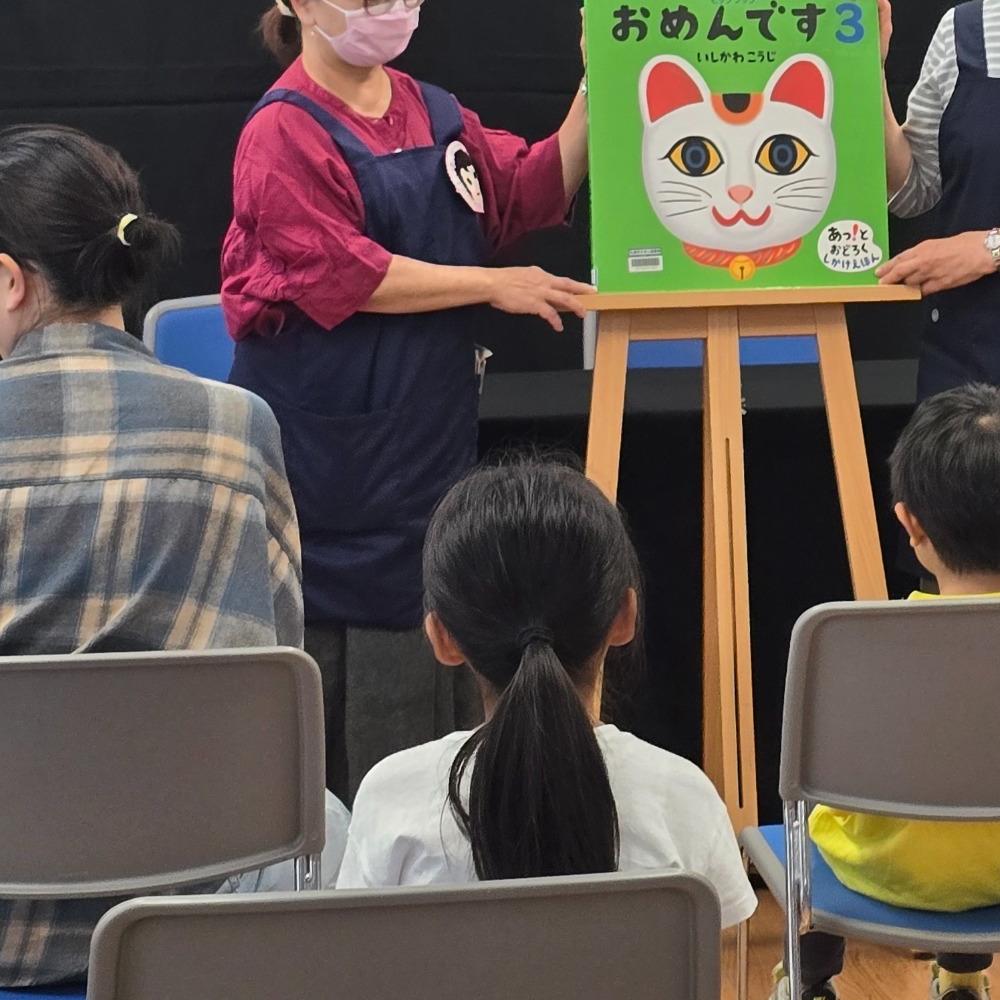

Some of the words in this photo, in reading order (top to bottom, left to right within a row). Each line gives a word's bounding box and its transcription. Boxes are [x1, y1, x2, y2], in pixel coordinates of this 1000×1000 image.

[830, 243, 868, 256] おどろく
[823, 253, 880, 270] しかけえほん
